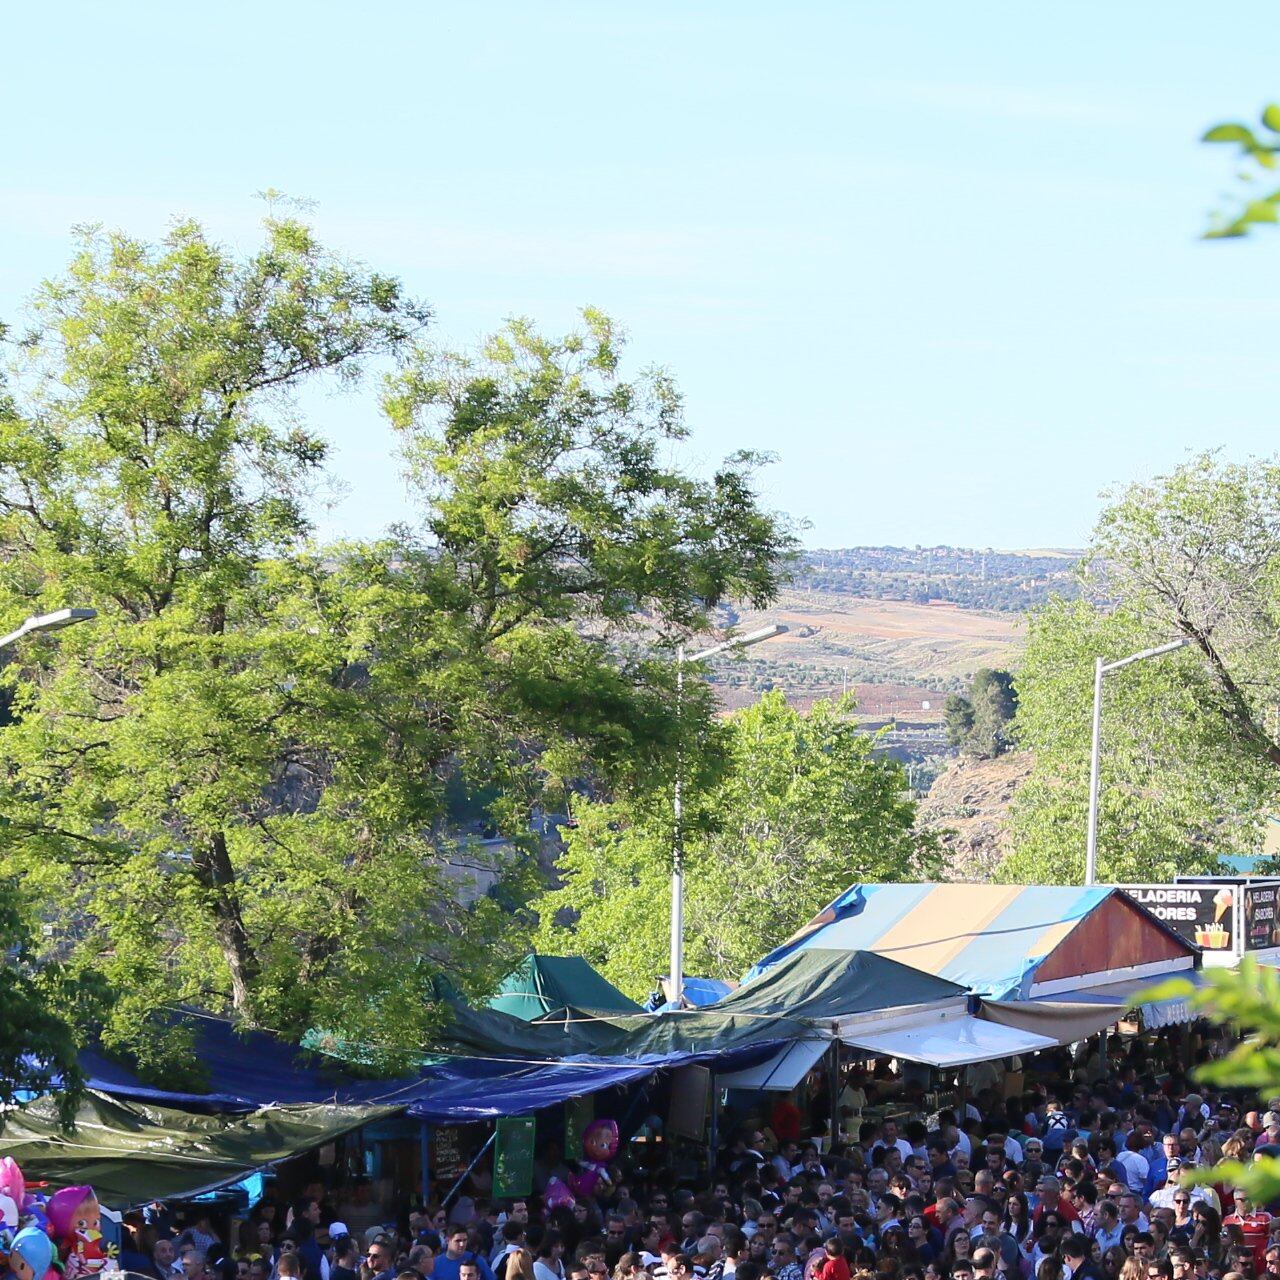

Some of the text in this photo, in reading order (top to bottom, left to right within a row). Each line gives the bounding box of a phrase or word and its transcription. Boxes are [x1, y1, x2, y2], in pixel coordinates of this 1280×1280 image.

[1125, 889, 1202, 903] ELADERIA
[1253, 891, 1274, 902] HELADERIA
[1147, 907, 1197, 921] ORES
